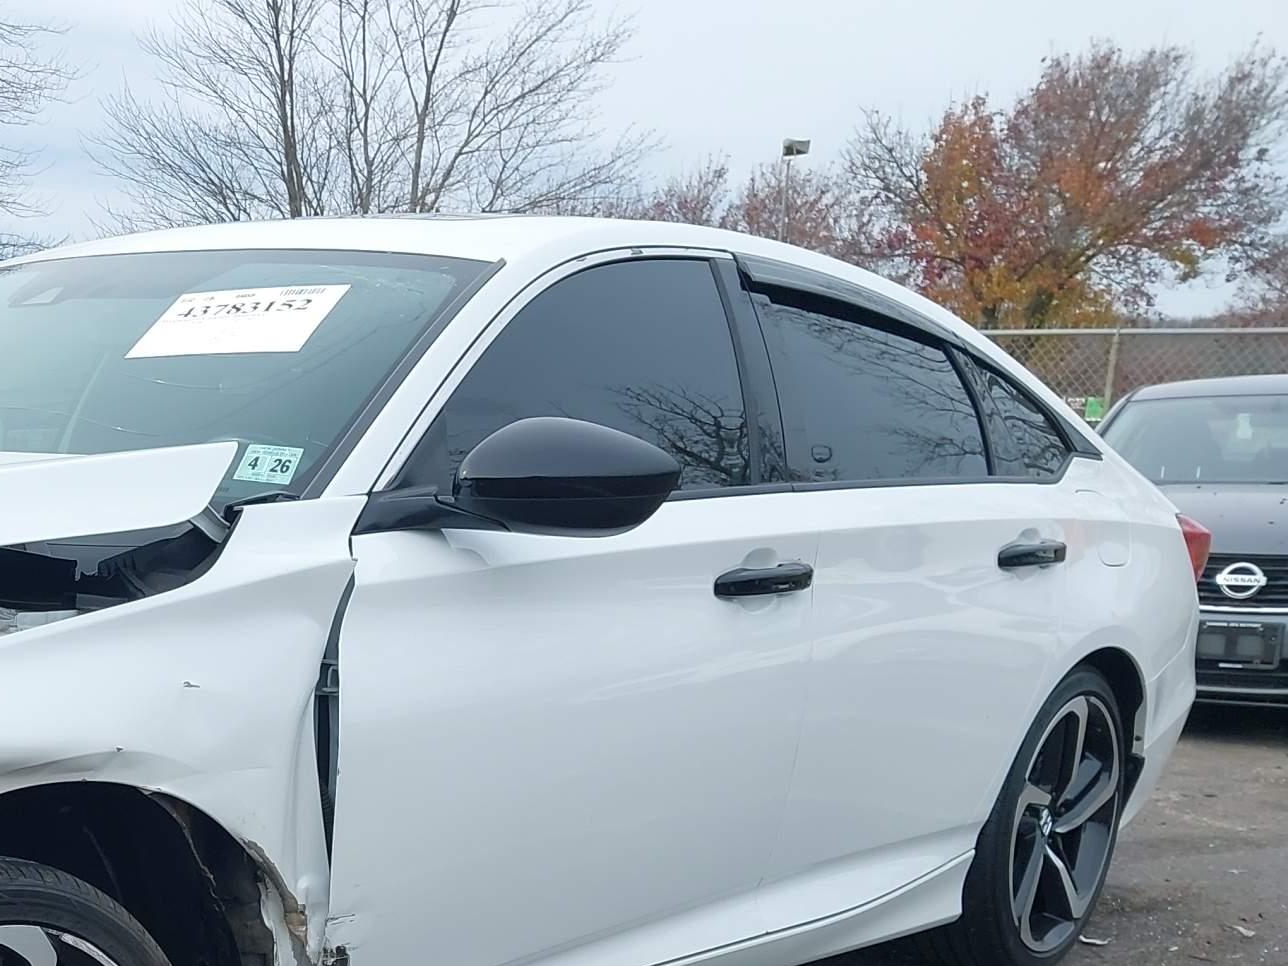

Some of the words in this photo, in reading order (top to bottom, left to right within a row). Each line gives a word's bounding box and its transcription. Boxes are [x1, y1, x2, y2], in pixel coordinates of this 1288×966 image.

[176, 299, 313, 318] 43783152
[248, 456, 260, 470] 4
[269, 458, 292, 474] 26
